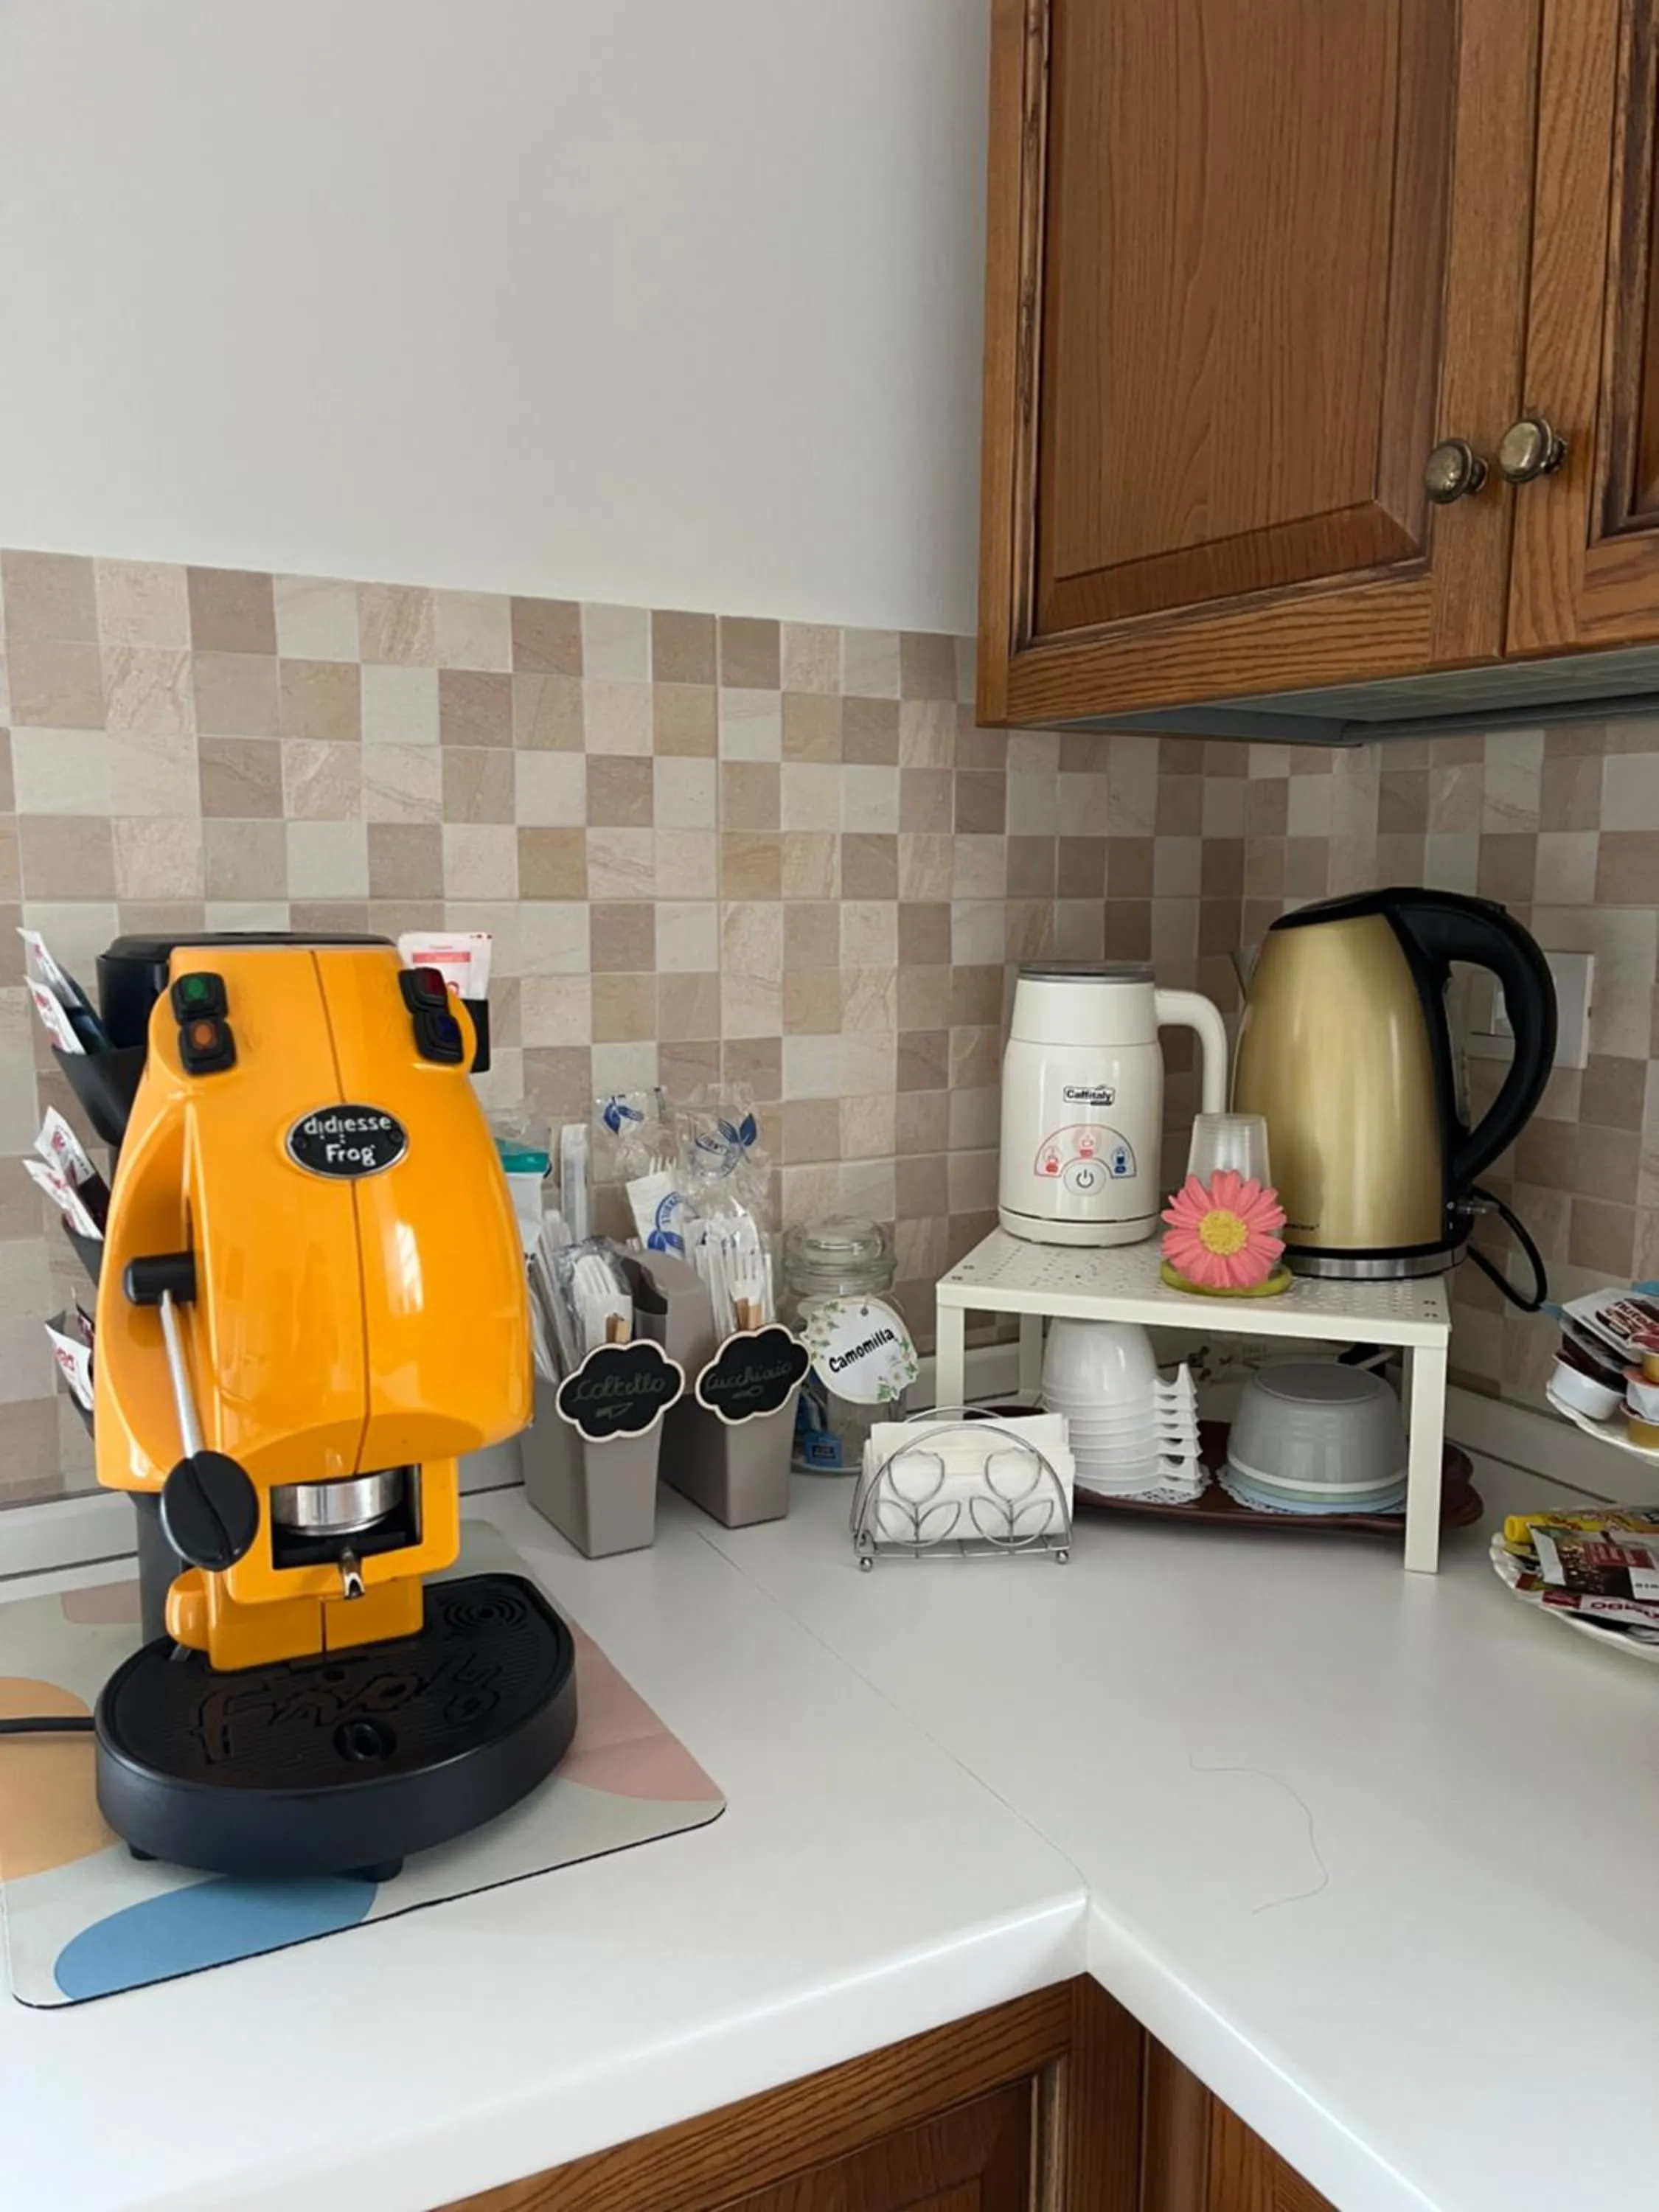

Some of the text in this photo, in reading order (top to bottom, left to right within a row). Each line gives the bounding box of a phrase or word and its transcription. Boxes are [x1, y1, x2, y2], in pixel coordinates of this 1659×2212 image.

[303, 1115, 392, 1140] didiesse
[325, 1143, 377, 1166] Frog
[828, 1328, 894, 1373] Camomilla
